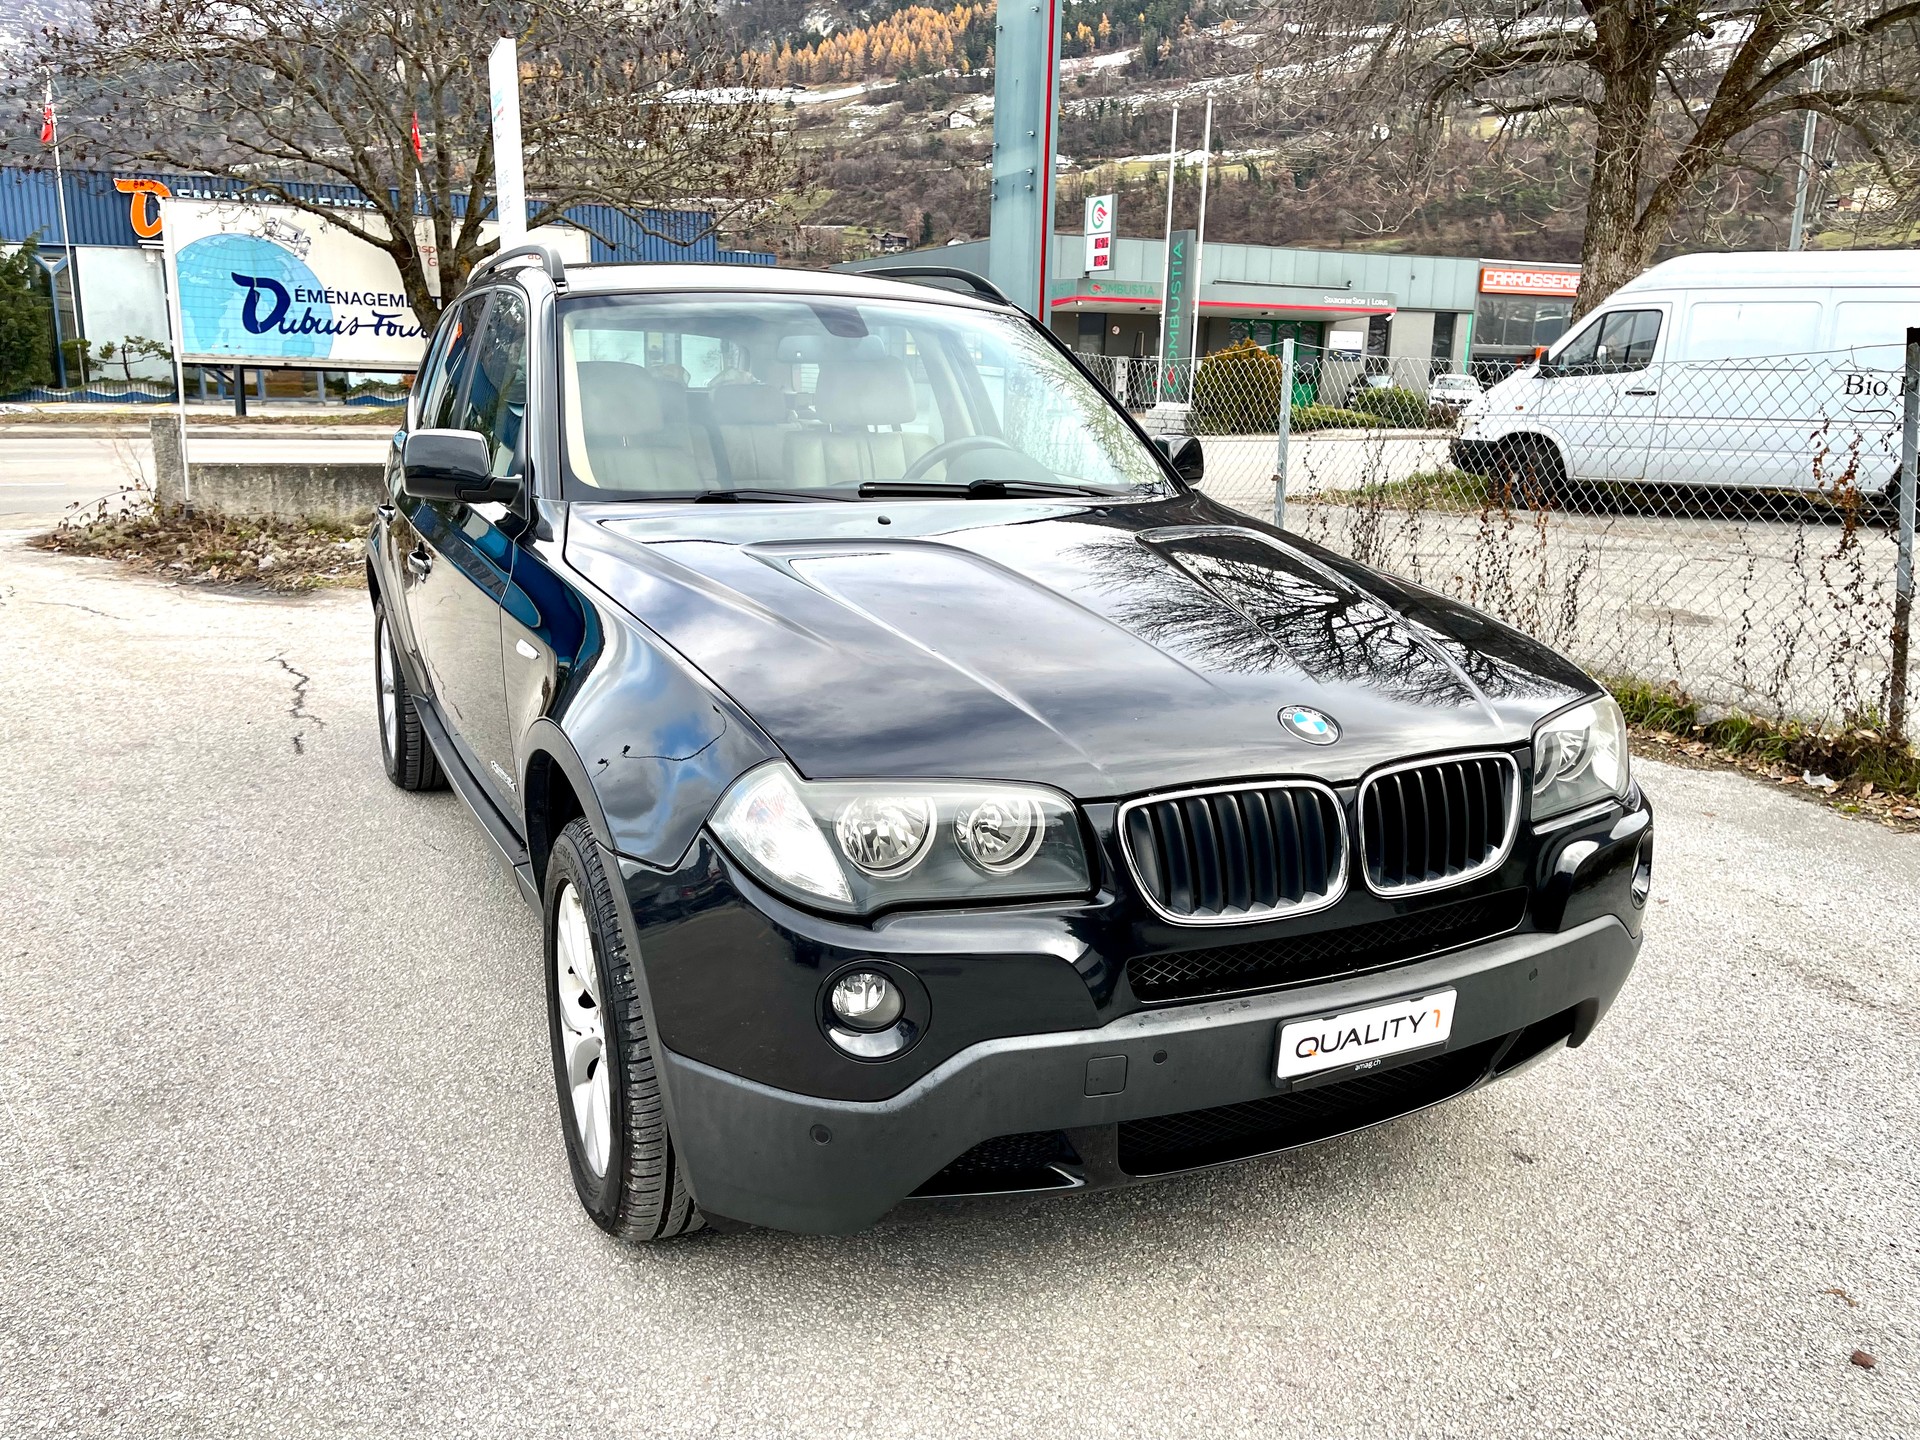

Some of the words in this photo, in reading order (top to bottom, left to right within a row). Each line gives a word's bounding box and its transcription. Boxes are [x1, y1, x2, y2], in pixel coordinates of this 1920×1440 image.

[1087, 280, 1155, 296] COMBUSTIA
[1483, 270, 1581, 289] CARROSSERIE
[1164, 238, 1184, 393] COMBUSTIA
[1844, 374, 1888, 396] Bio
[1295, 1011, 1427, 1058] QUALITY
[1433, 1009, 1441, 1028] 1
[1354, 1058, 1381, 1071] amag.ch
